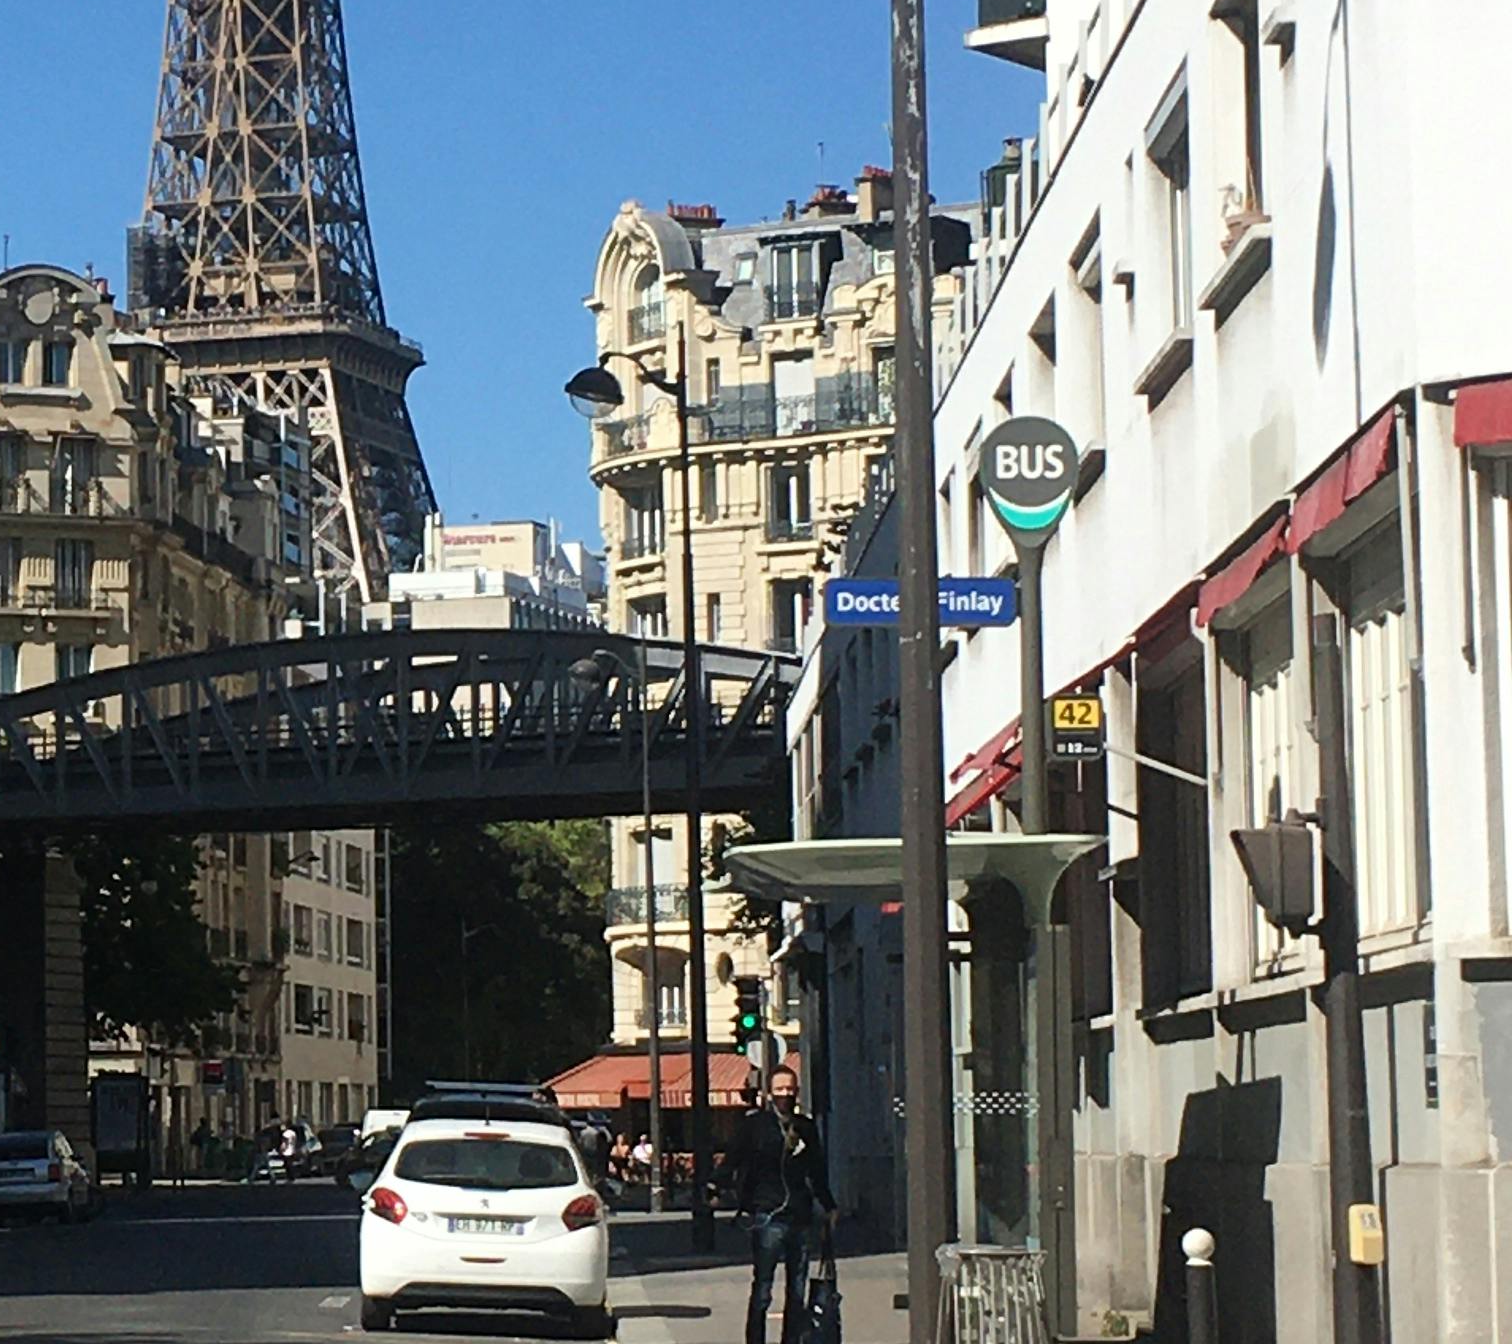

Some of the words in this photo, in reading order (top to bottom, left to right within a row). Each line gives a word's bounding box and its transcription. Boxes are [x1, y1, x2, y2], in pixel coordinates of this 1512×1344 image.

[996, 444, 1065, 480] BUS
[938, 590, 1004, 616] Finlay
[1058, 702, 1092, 725] 42
